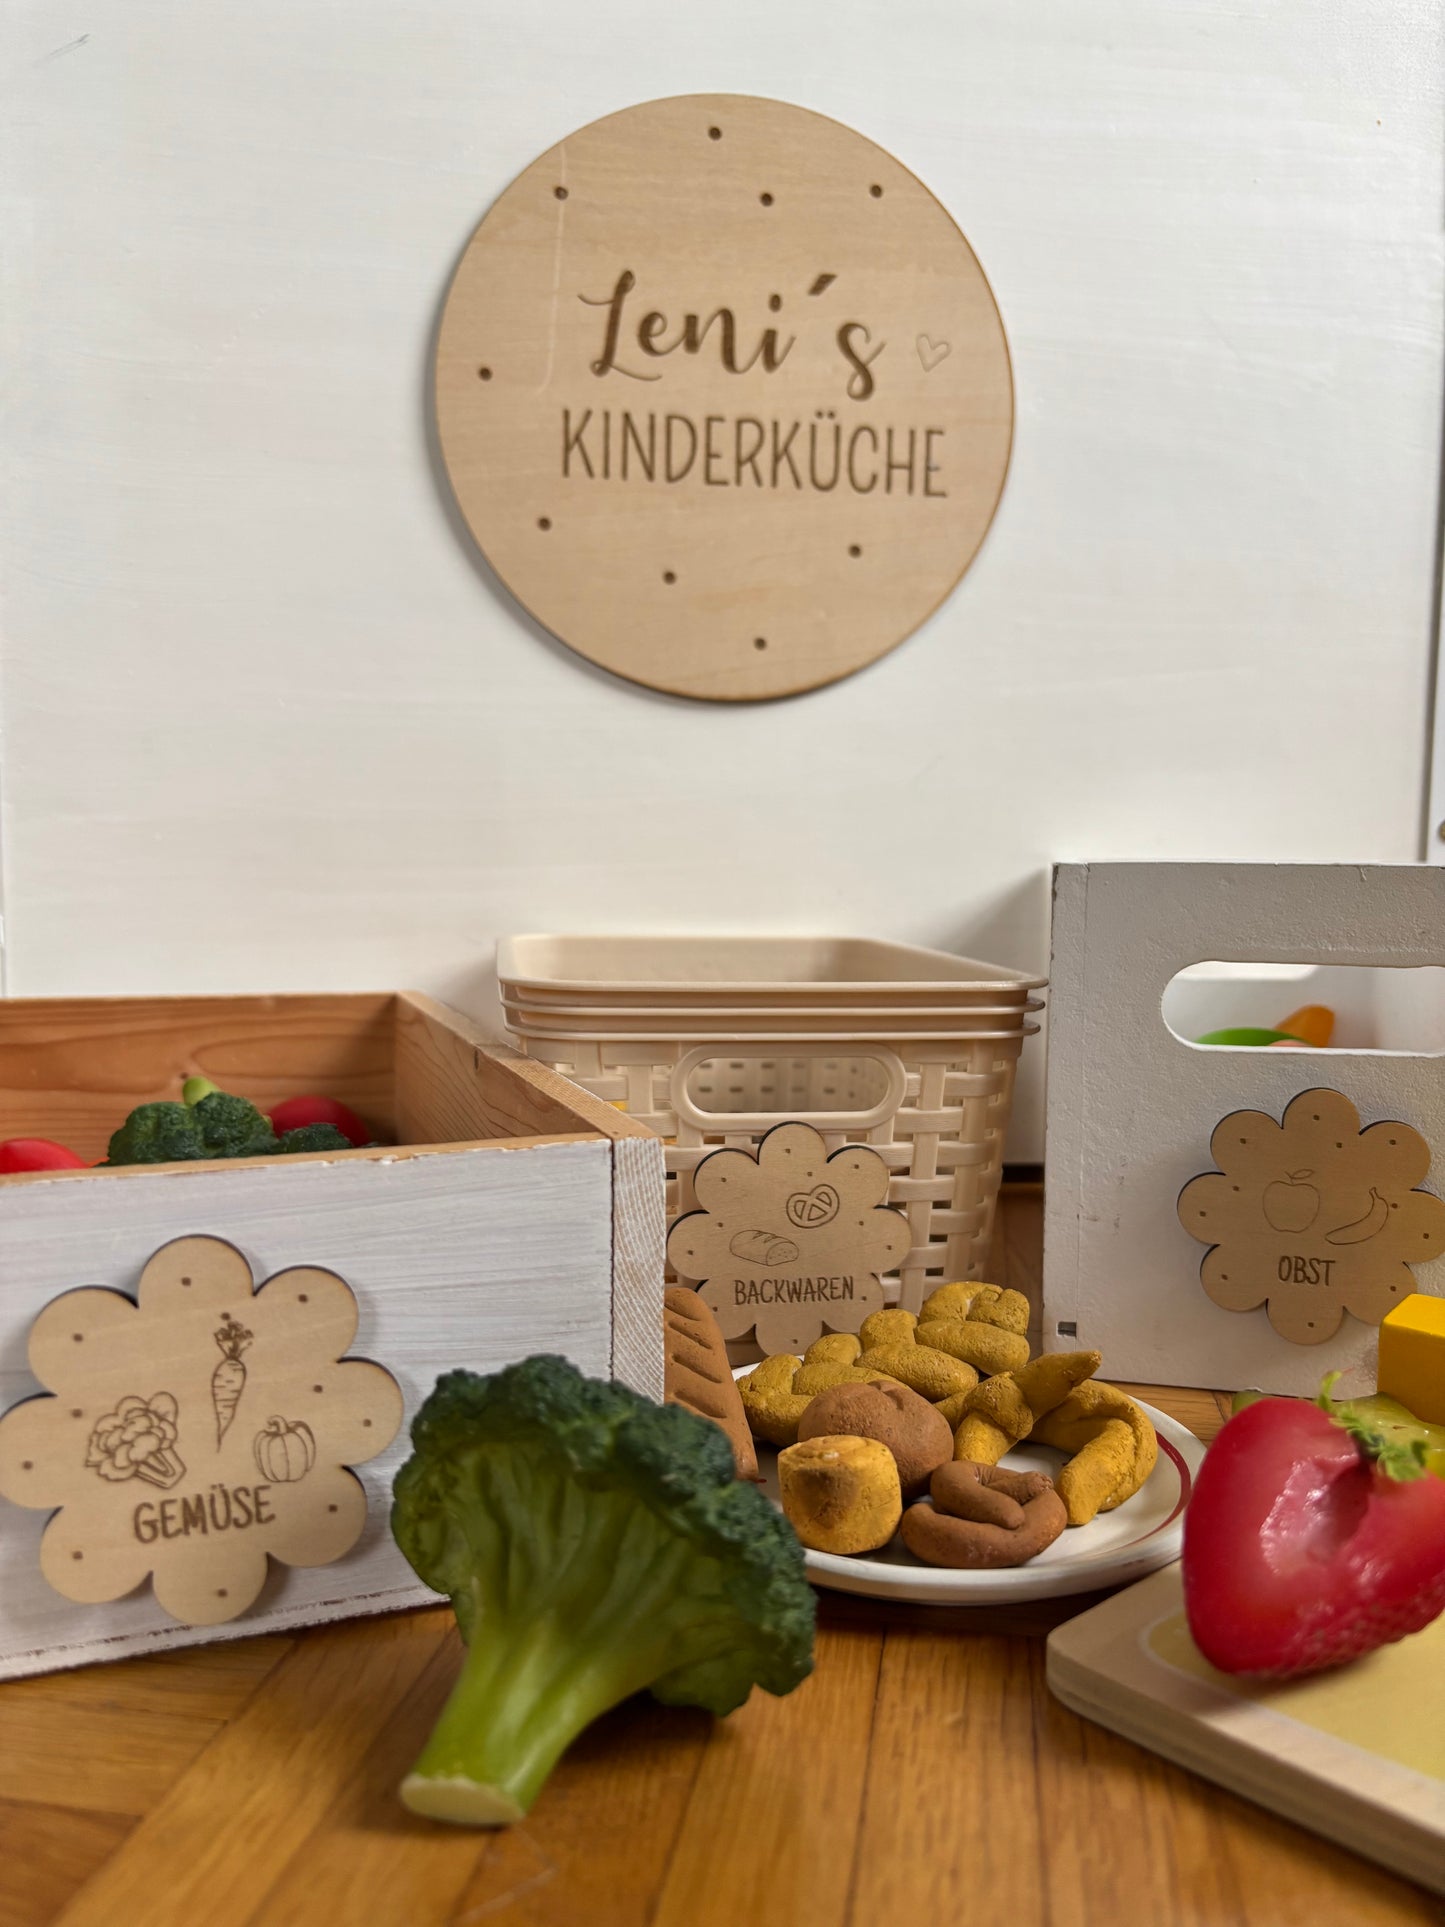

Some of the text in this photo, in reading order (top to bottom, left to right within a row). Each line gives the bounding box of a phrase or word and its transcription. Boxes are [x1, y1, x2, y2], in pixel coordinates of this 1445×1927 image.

[562, 408, 949, 498] KINDERKÜCHE
[733, 1276, 855, 1306] BACKWAREN
[1278, 1256, 1336, 1287] OBST
[133, 1483, 276, 1545] GEMÜSE
